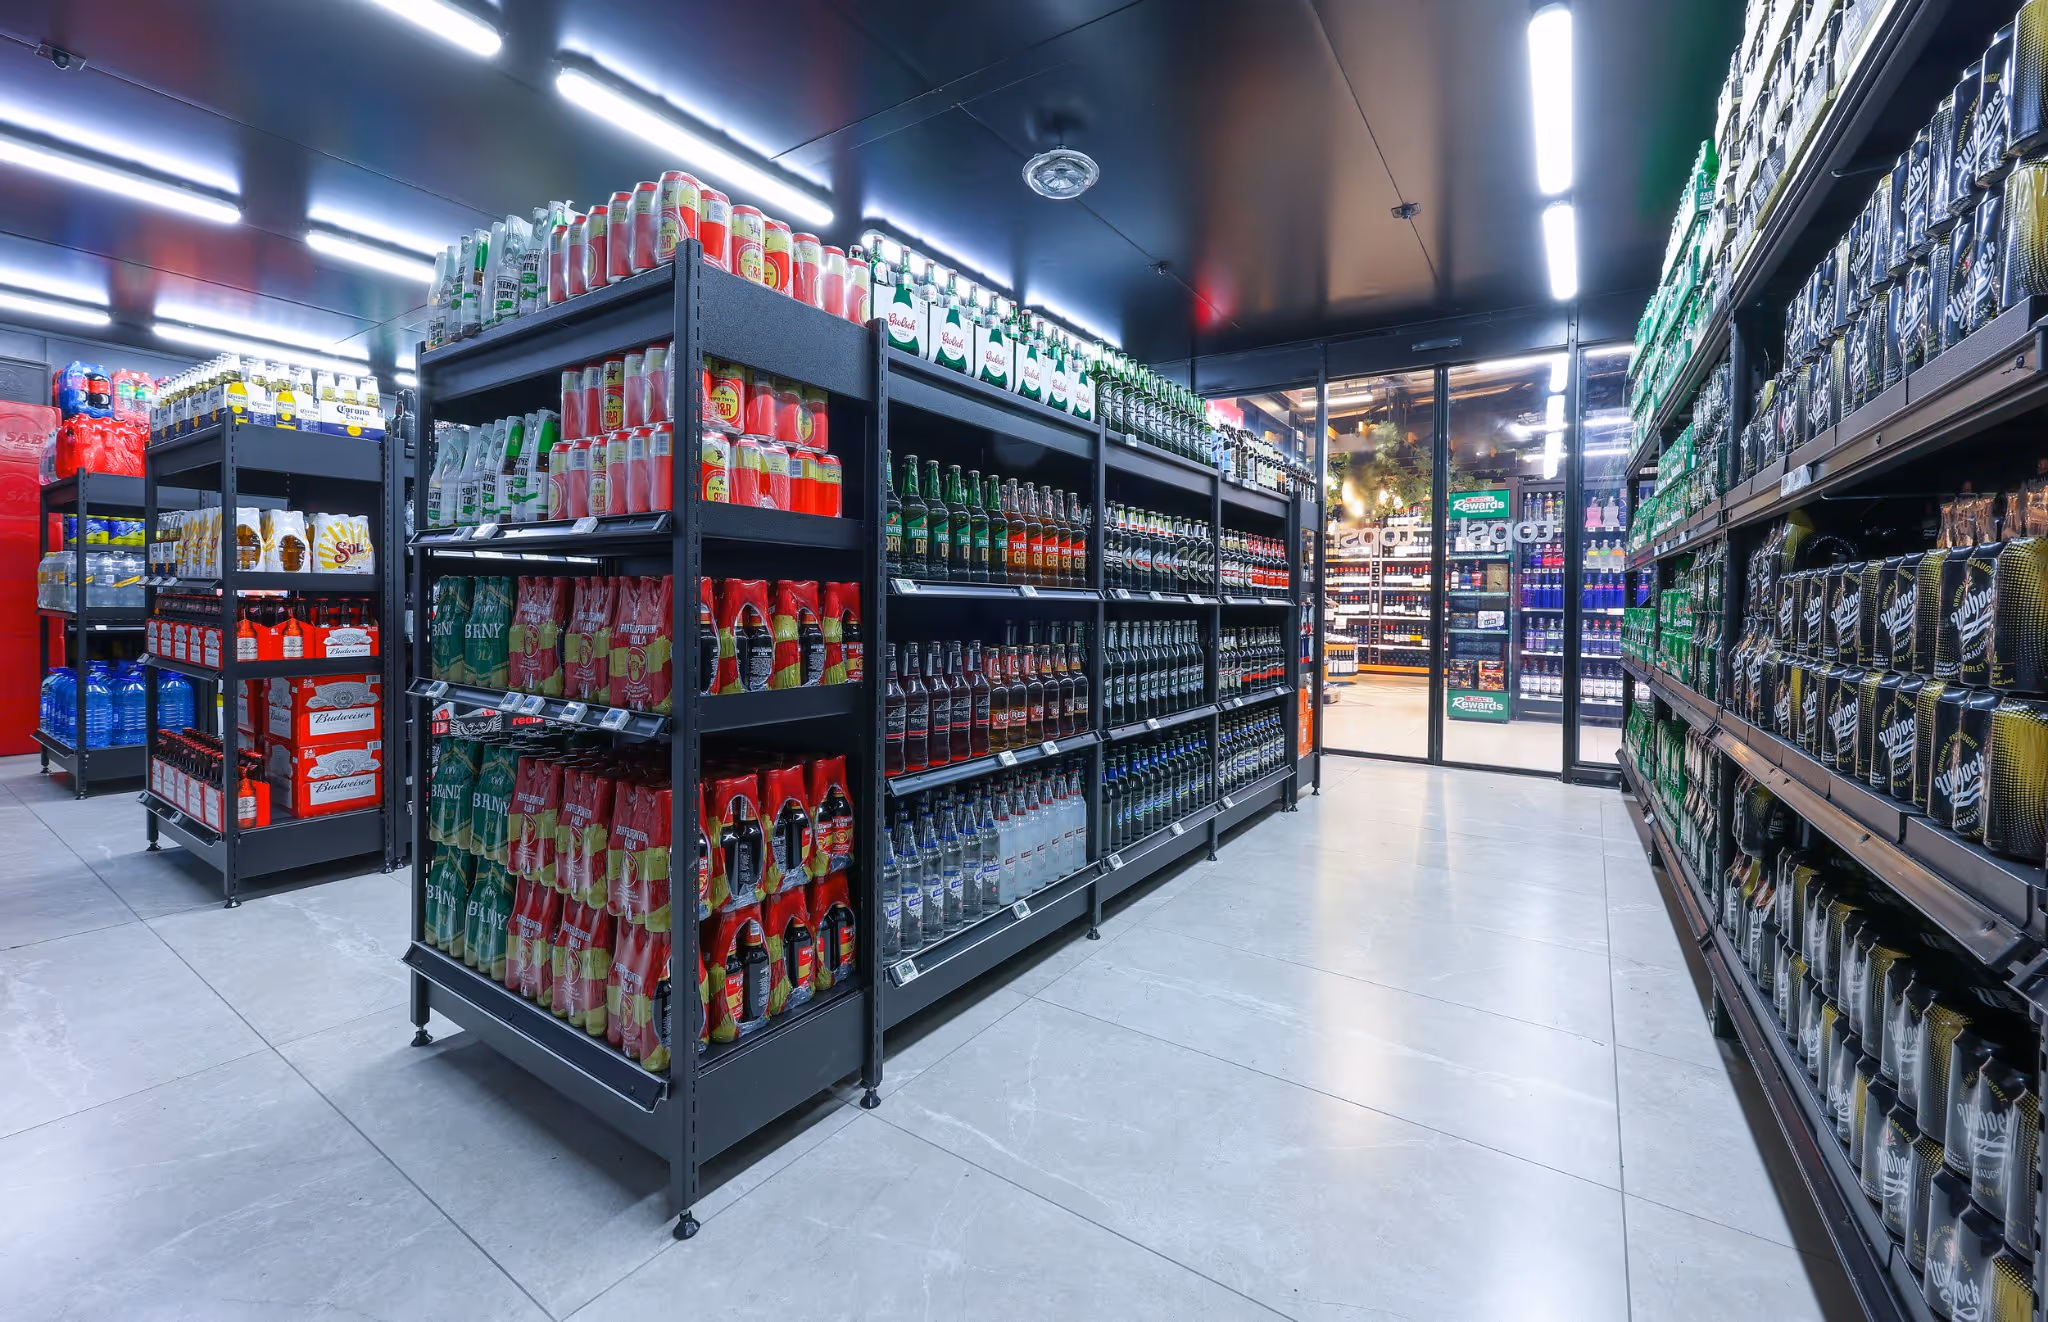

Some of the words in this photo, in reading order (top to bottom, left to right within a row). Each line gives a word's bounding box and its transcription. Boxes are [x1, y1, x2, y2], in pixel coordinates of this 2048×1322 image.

[336, 404, 370, 416] Corona
[5, 431, 44, 445] SAB
[1453, 499, 1505, 512] Rewards
[1452, 696, 1504, 712] Rewards
[313, 711, 372, 724] Budweiser
[313, 778, 372, 794] Budweiser
